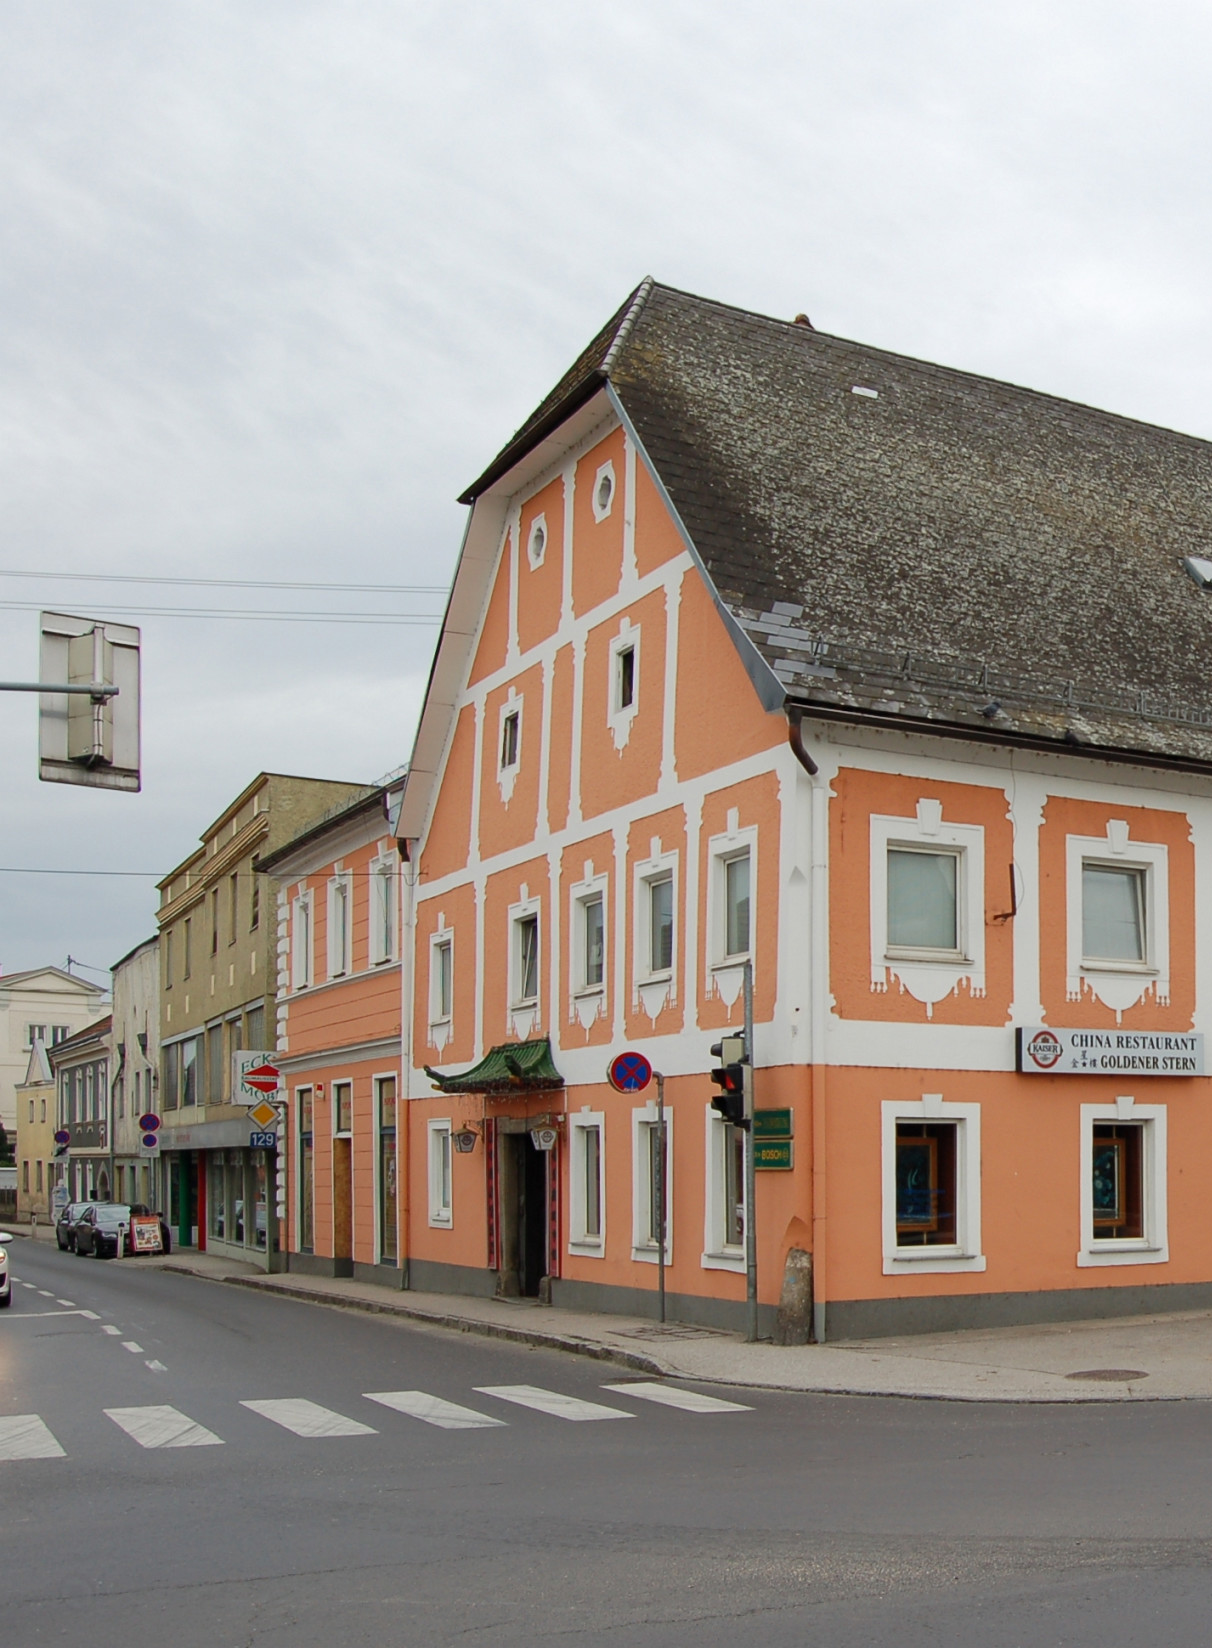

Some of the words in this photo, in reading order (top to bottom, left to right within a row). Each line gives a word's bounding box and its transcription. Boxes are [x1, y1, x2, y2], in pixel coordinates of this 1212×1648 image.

[1033, 1044, 1058, 1054] KAISER
[1071, 1034, 1111, 1048] CHINA
[1116, 1037, 1196, 1051] RESTAURANT
[1101, 1055, 1158, 1070] GOLDENER
[1162, 1057, 1196, 1070] STERN
[252, 1134, 274, 1146] 129
